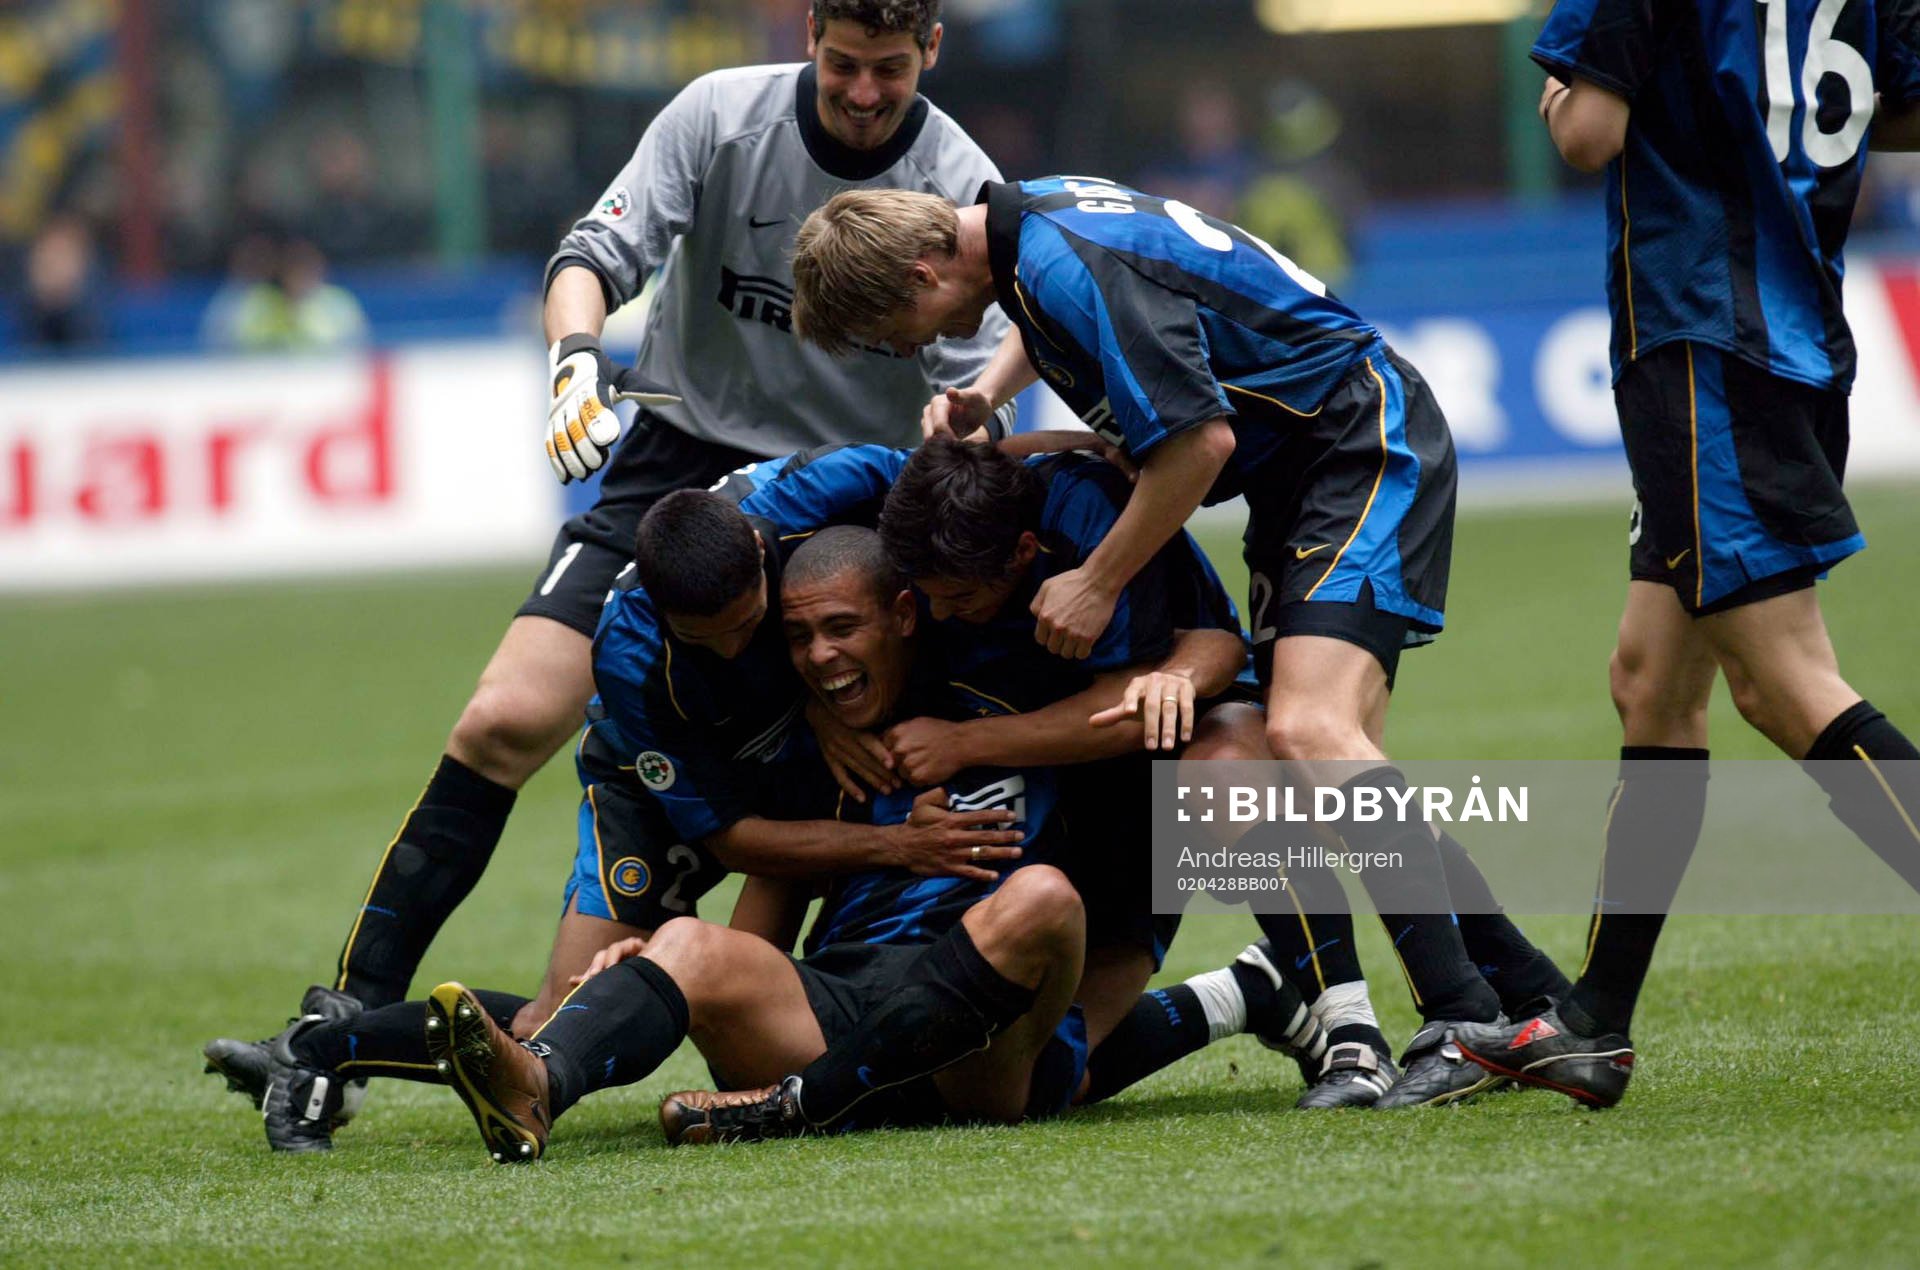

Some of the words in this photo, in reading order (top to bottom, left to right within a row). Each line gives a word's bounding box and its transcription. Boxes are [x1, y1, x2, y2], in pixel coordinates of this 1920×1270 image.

[1756, 0, 1874, 168] 16
[540, 542, 584, 596] 1
[660, 844, 700, 912] 2
